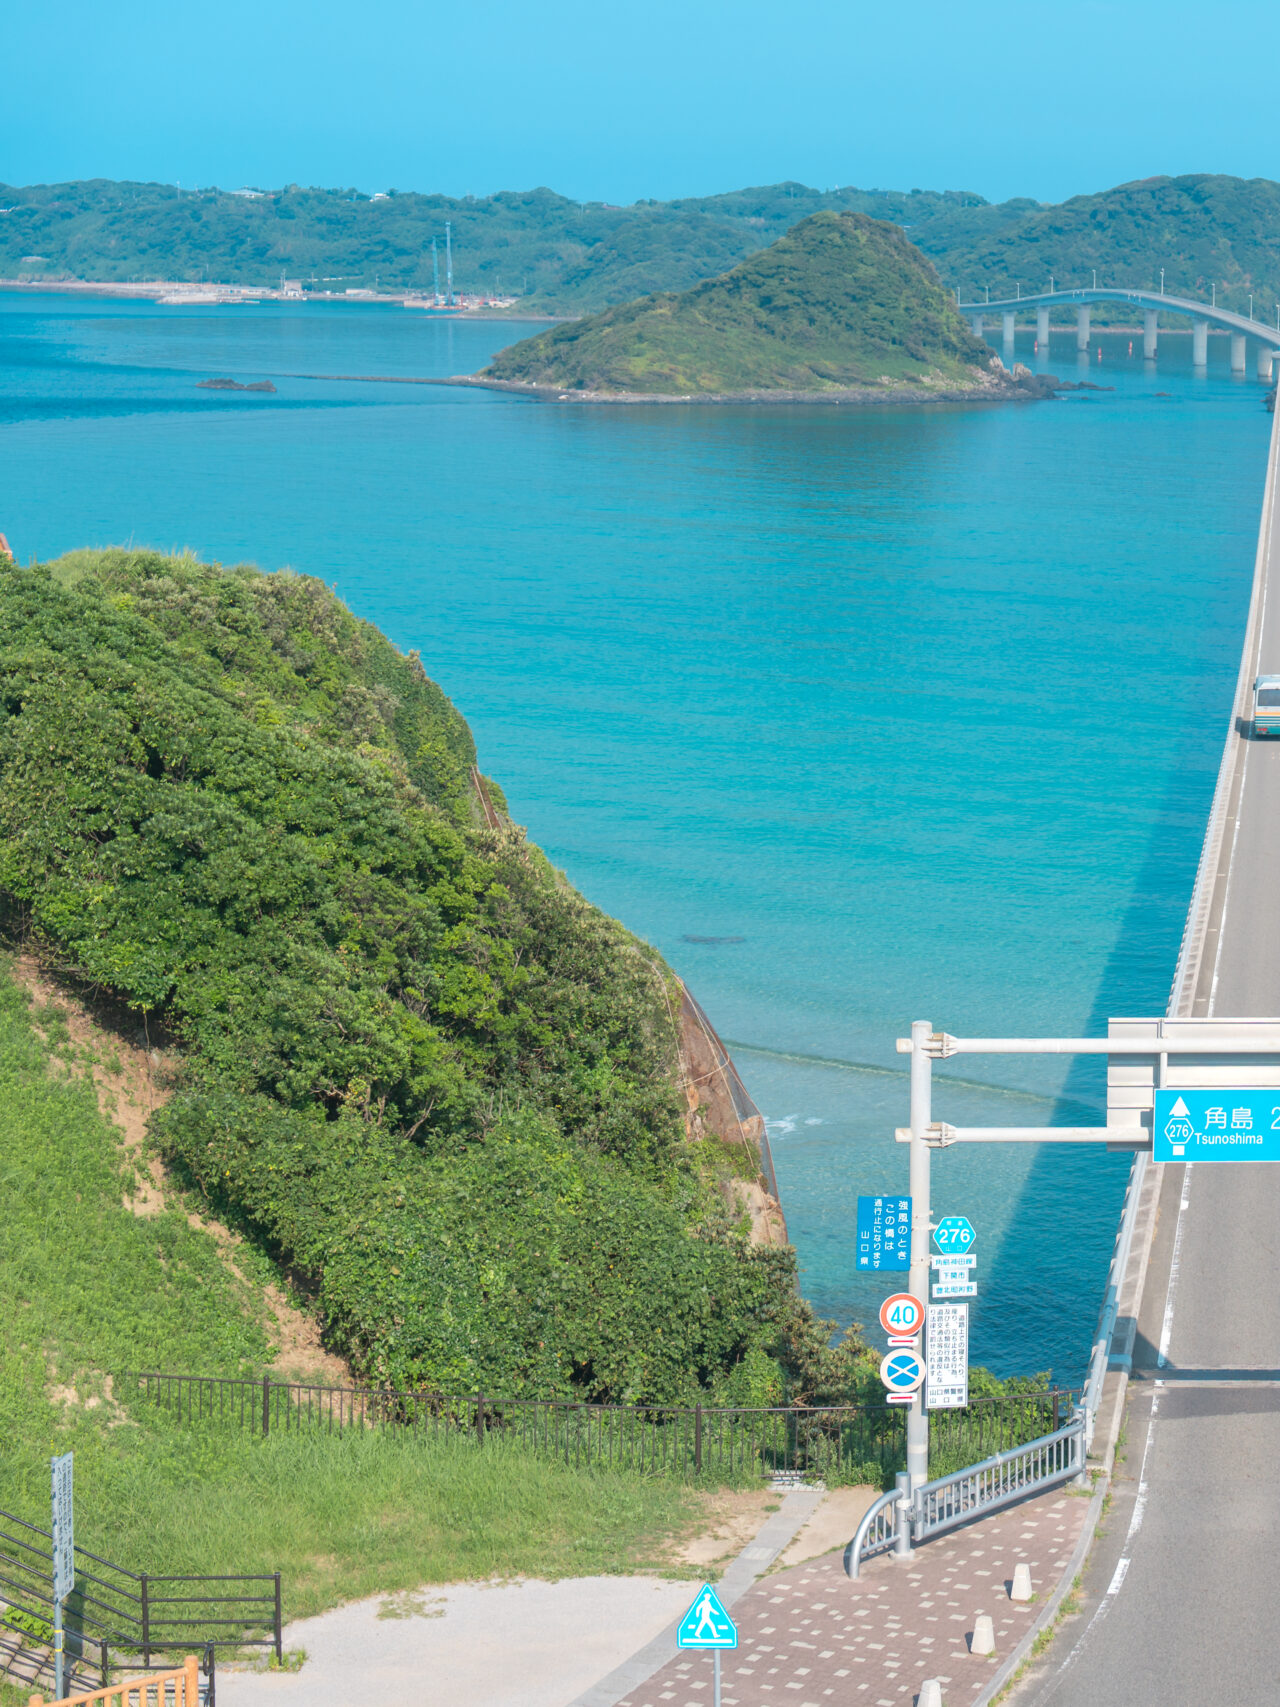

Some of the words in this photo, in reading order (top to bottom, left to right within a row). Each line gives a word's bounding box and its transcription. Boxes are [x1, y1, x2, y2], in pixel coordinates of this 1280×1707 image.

[1204, 1106, 1254, 1130] 角島
[1169, 1124, 1189, 1138] 276
[1194, 1132, 1263, 1145] Tsunoshima
[873, 1198, 883, 1269] 通行止になります
[884, 1203, 895, 1251] この橋は
[897, 1200, 909, 1260] 強風のとき
[938, 1228, 971, 1244] 276
[860, 1230, 870, 1266] 山口県
[890, 1305, 916, 1326] 40
